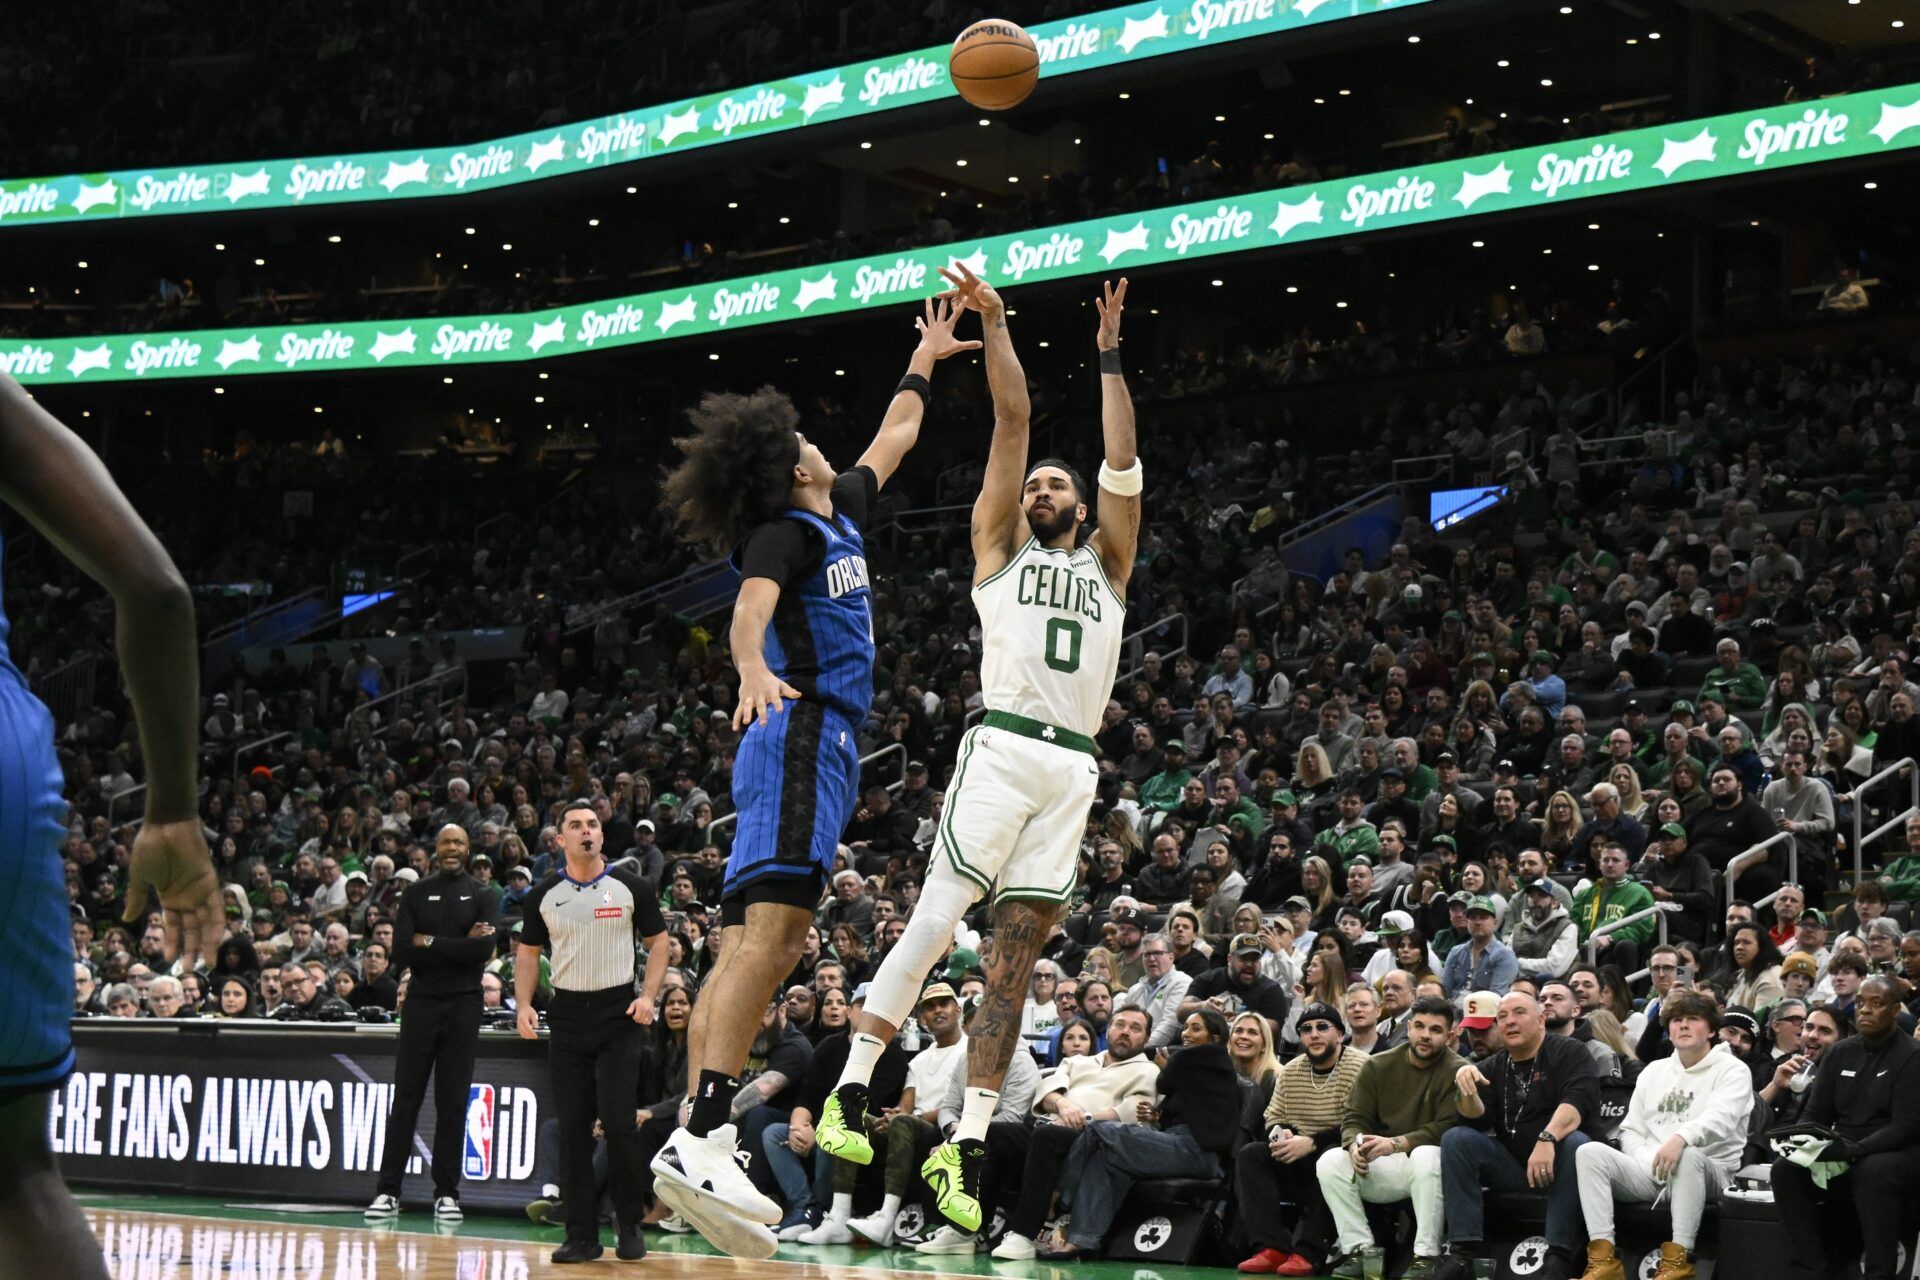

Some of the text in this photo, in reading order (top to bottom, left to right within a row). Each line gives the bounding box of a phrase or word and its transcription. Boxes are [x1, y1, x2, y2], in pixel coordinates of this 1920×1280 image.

[0, 183, 59, 220] prite
[131, 172, 209, 211] Sprite
[285, 161, 366, 201] Sprite
[443, 147, 513, 189] Sprite
[576, 118, 646, 164] Sprite
[713, 89, 786, 136] Sprite
[859, 57, 938, 107] Sprite
[1033, 23, 1101, 65] prite
[125, 337, 202, 375] Sprite
[275, 329, 355, 368] Sprite
[431, 322, 513, 360] Sprite
[577, 303, 643, 346] Sprite
[708, 282, 780, 326] Sprite
[850, 258, 927, 304] Sprite
[1002, 233, 1084, 280] Sprite
[1164, 205, 1254, 255] Sprite
[1340, 176, 1436, 227] Sprite
[1530, 143, 1634, 198] Sprite
[1737, 108, 1849, 165] Sprite
[1018, 564, 1102, 623] CELTICS
[1044, 616, 1083, 674] 0
[595, 909, 622, 918] Emirates
[1468, 1000, 1478, 1015] S
[48, 1071, 107, 1155] ERE
[110, 1073, 193, 1161] FANS
[196, 1076, 334, 1170] ALWAYS
[1600, 1101, 1625, 1117] tics
